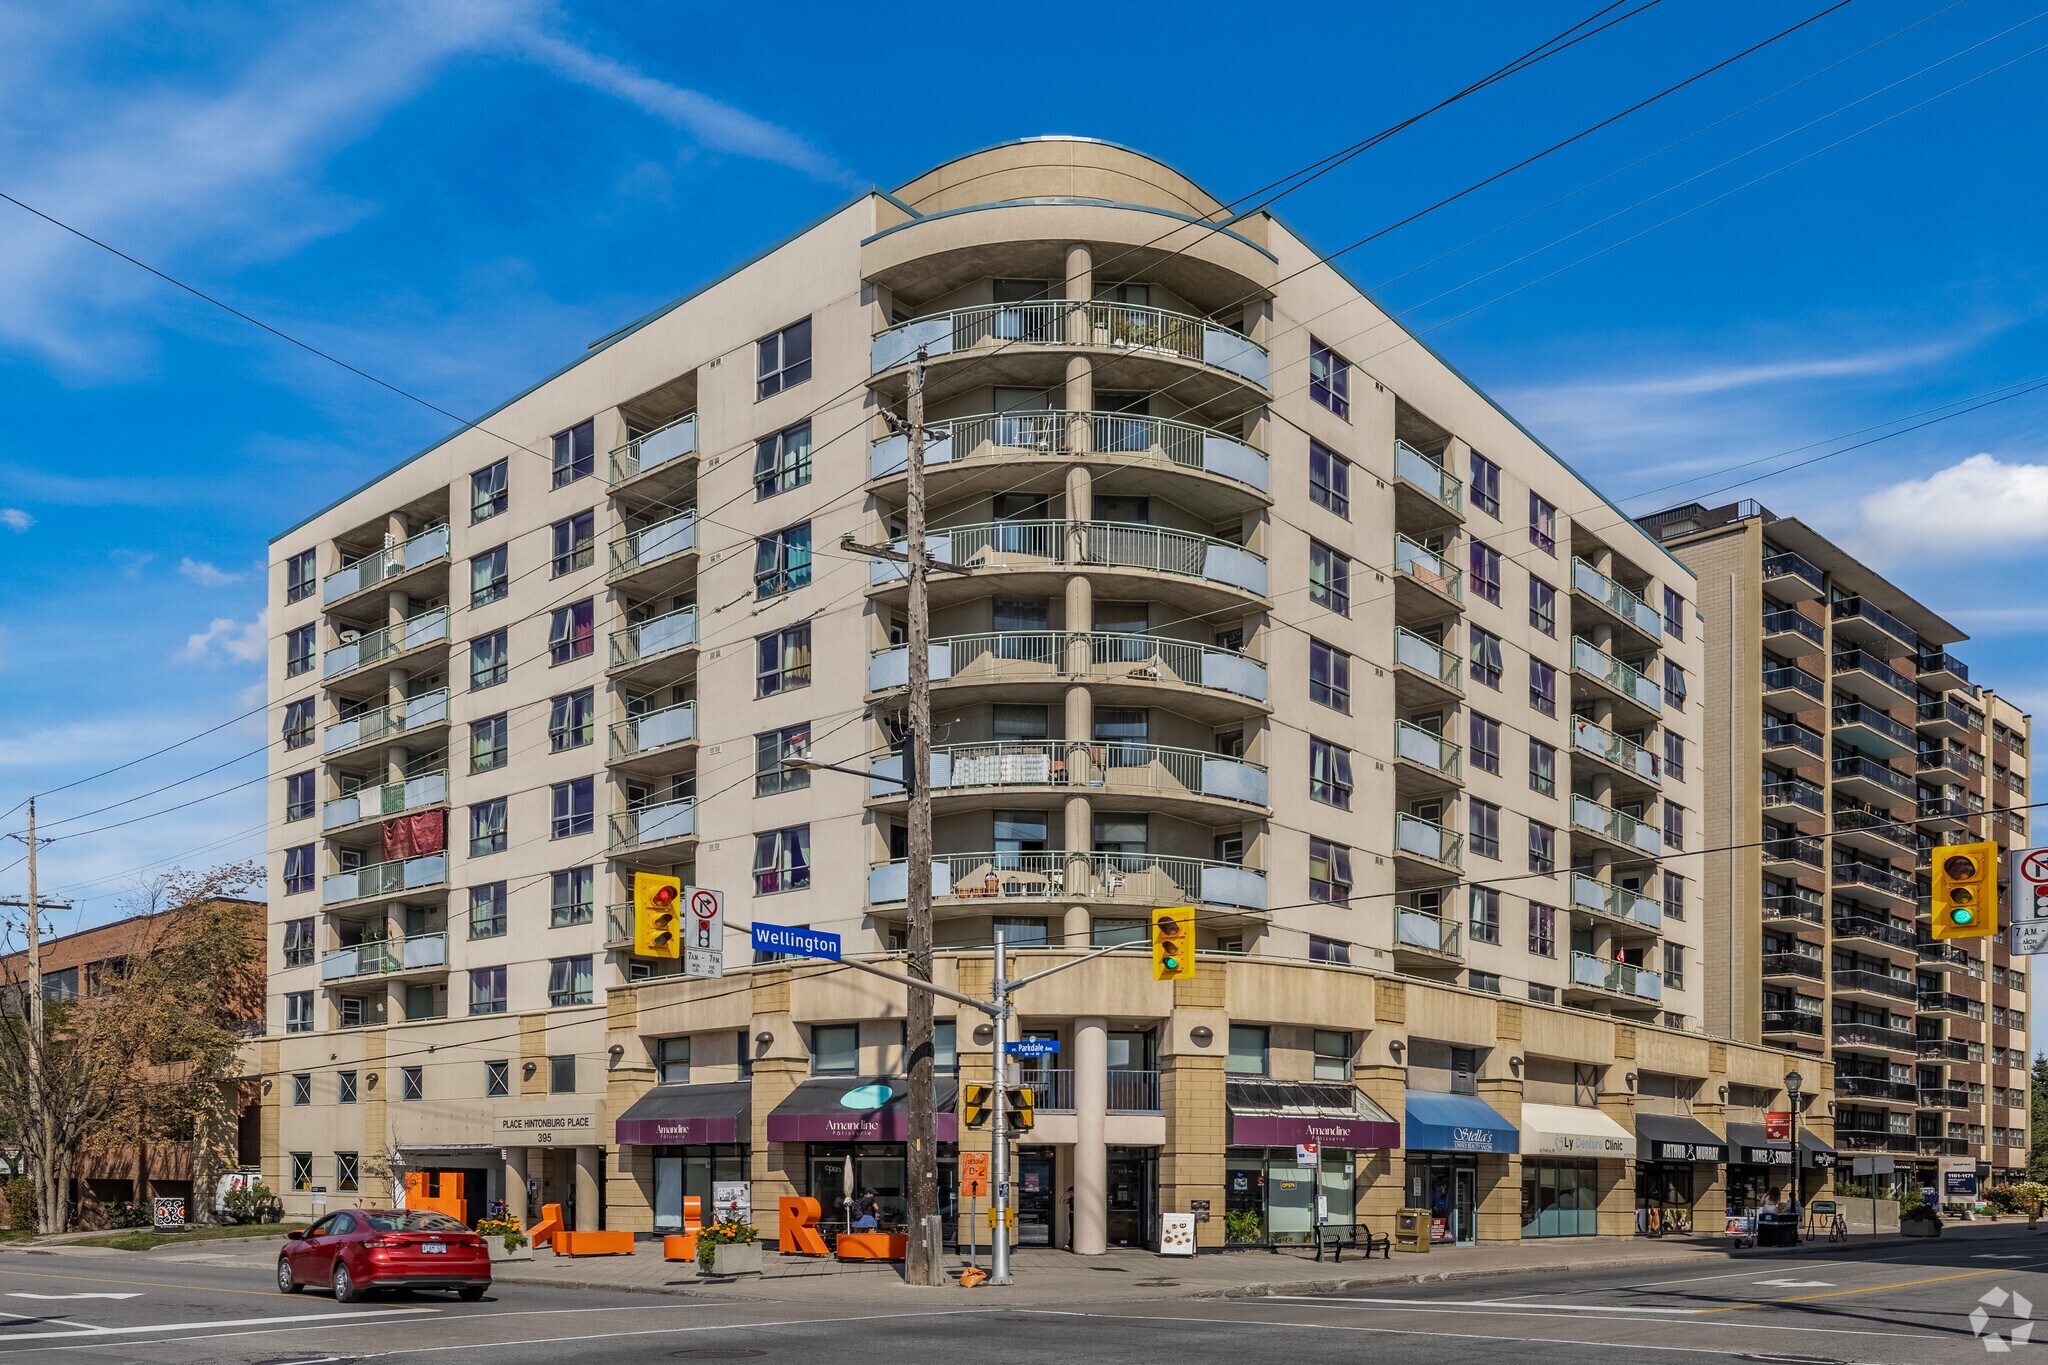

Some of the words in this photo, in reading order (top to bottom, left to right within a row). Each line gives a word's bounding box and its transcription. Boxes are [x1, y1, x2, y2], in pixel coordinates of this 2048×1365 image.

[2015, 928, 2021, 936] 7
[756, 928, 837, 953] Wellington
[1018, 1043, 1044, 1052] Parkdale
[502, 1120, 522, 1129] PLACE
[524, 1118, 565, 1128] HINTONBURG
[567, 1117, 589, 1127] PLACE
[656, 1124, 690, 1134] Amandine
[825, 1119, 879, 1130] Amandine
[1305, 1124, 1351, 1136] Amandine
[1453, 1127, 1493, 1143] Stella's
[537, 1133, 552, 1143] 395
[1564, 1136, 1574, 1150] Ly
[1575, 1138, 1603, 1150] Denture
[1604, 1139, 1623, 1151] Clinic
[1662, 1143, 1686, 1158] ARTHUR
[1696, 1145, 1719, 1160] MURRAY
[1752, 1149, 1768, 1162] DANCE
